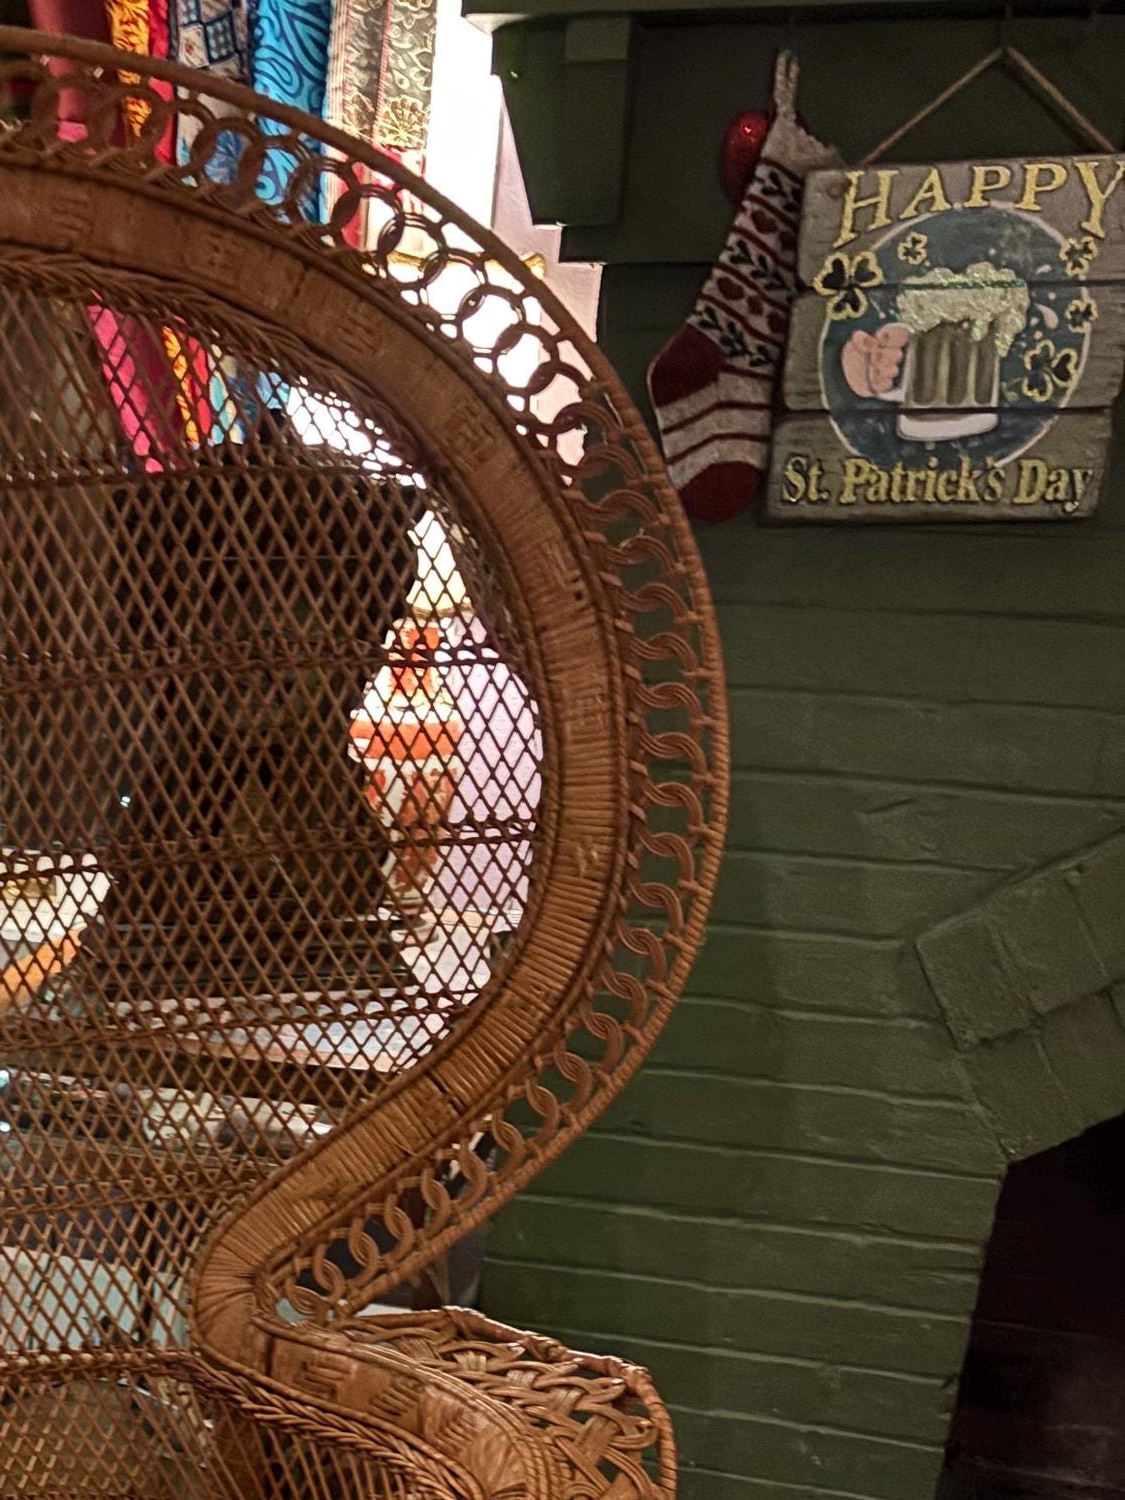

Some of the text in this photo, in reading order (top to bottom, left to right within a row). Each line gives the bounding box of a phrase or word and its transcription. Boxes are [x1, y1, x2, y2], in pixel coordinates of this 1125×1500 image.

[833, 161, 1125, 248] HAPPY
[783, 455, 1093, 512] St. Patrick's Day
